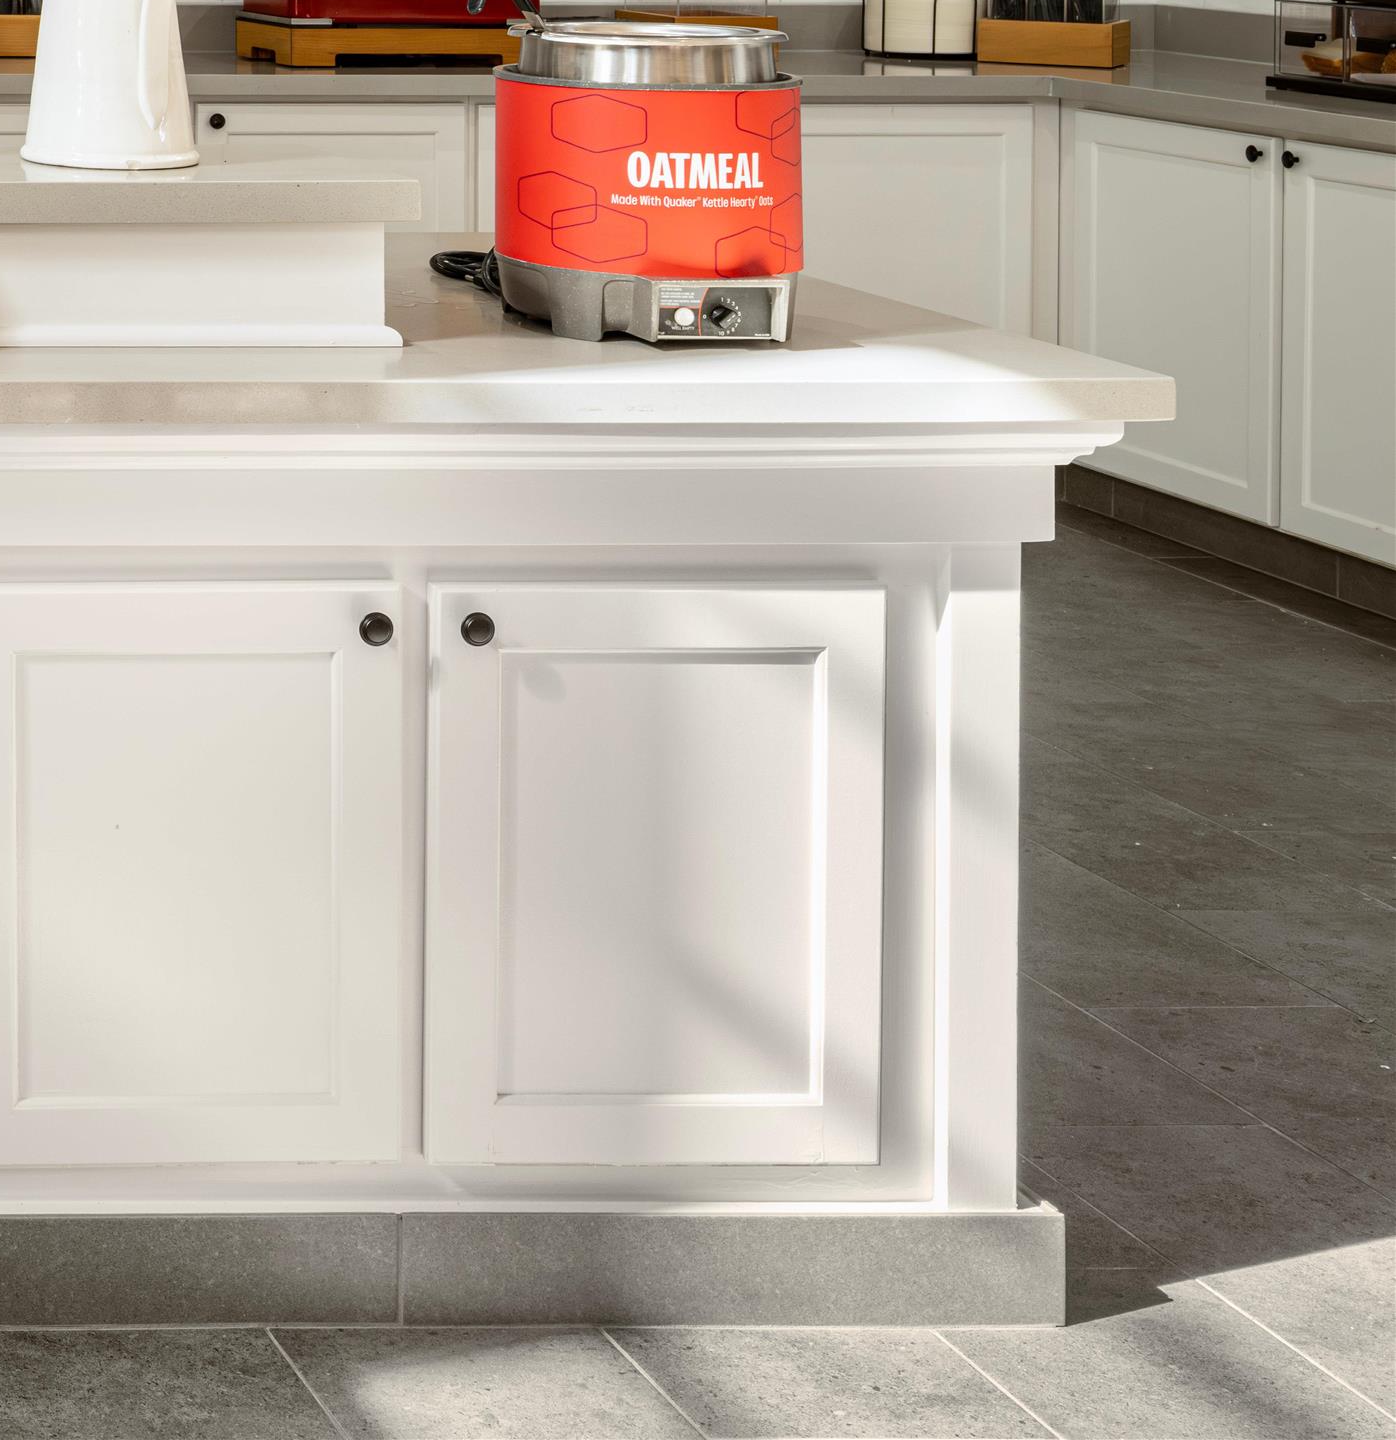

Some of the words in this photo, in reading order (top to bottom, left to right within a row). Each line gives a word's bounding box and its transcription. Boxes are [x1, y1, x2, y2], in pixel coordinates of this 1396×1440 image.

[627, 150, 764, 189] OATMEAL
[611, 194, 638, 205] Made
[639, 195, 662, 206] With
[702, 197, 729, 208] Kettle
[759, 196, 774, 206] Oats
